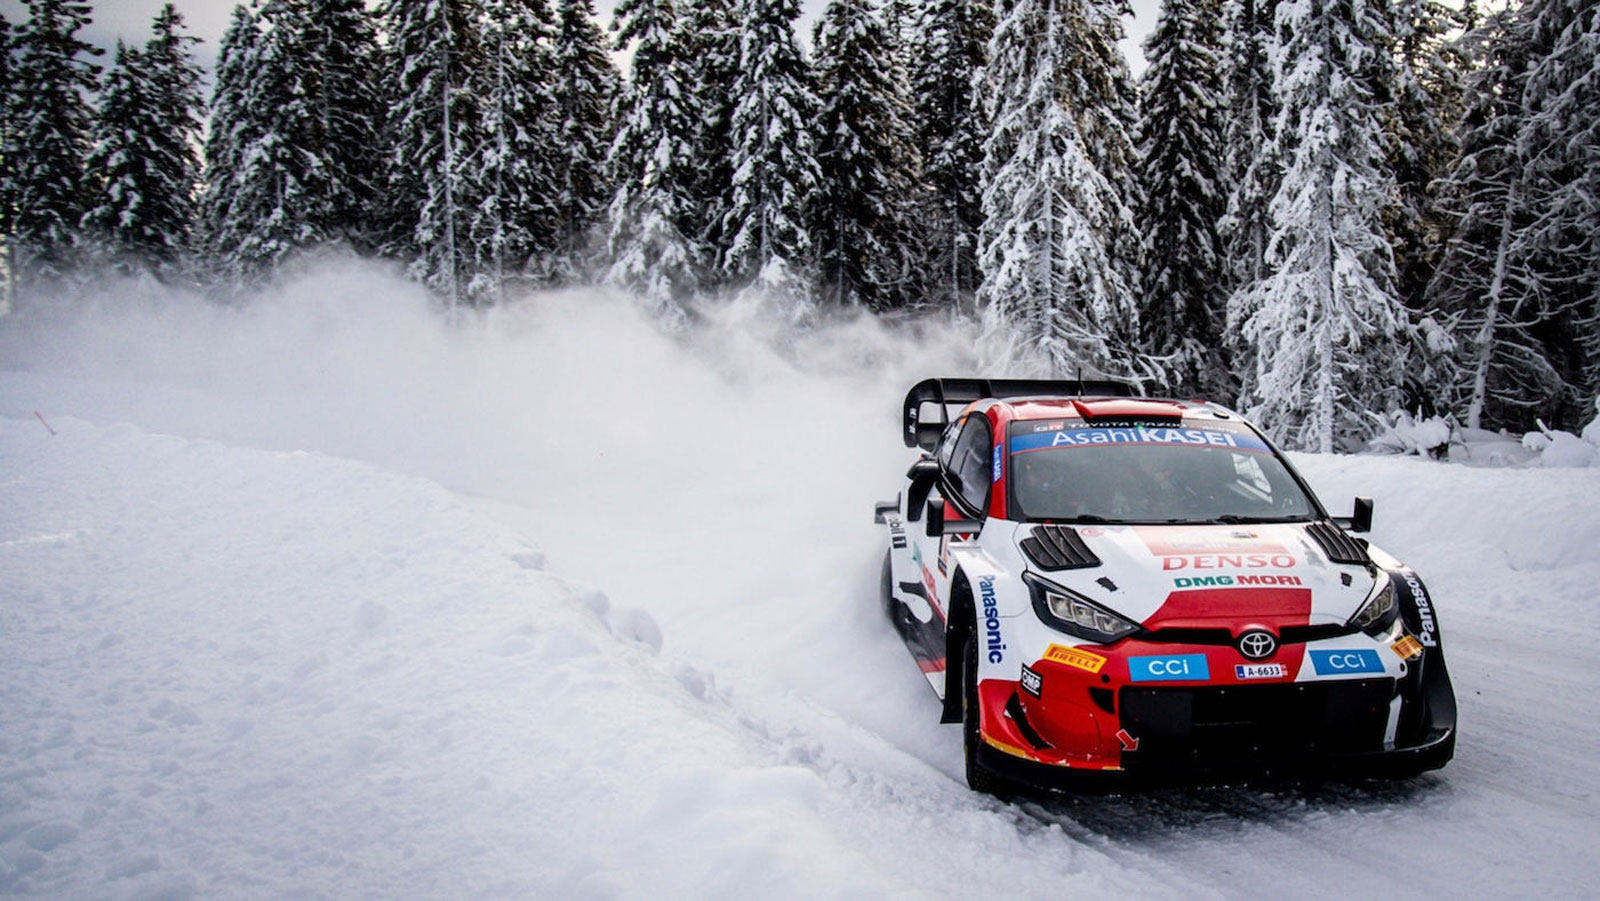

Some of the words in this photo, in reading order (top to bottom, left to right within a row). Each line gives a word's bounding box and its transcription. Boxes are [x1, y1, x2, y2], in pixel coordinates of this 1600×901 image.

[1163, 554, 1297, 571] DENSO
[1174, 575, 1234, 588] DMG
[1236, 575, 1302, 586] MORI
[978, 575, 1007, 664] Panasonic
[1050, 646, 1101, 669] PIRELLI
[1022, 670, 1041, 691] OMP
[1248, 665, 1280, 677] A-6633
